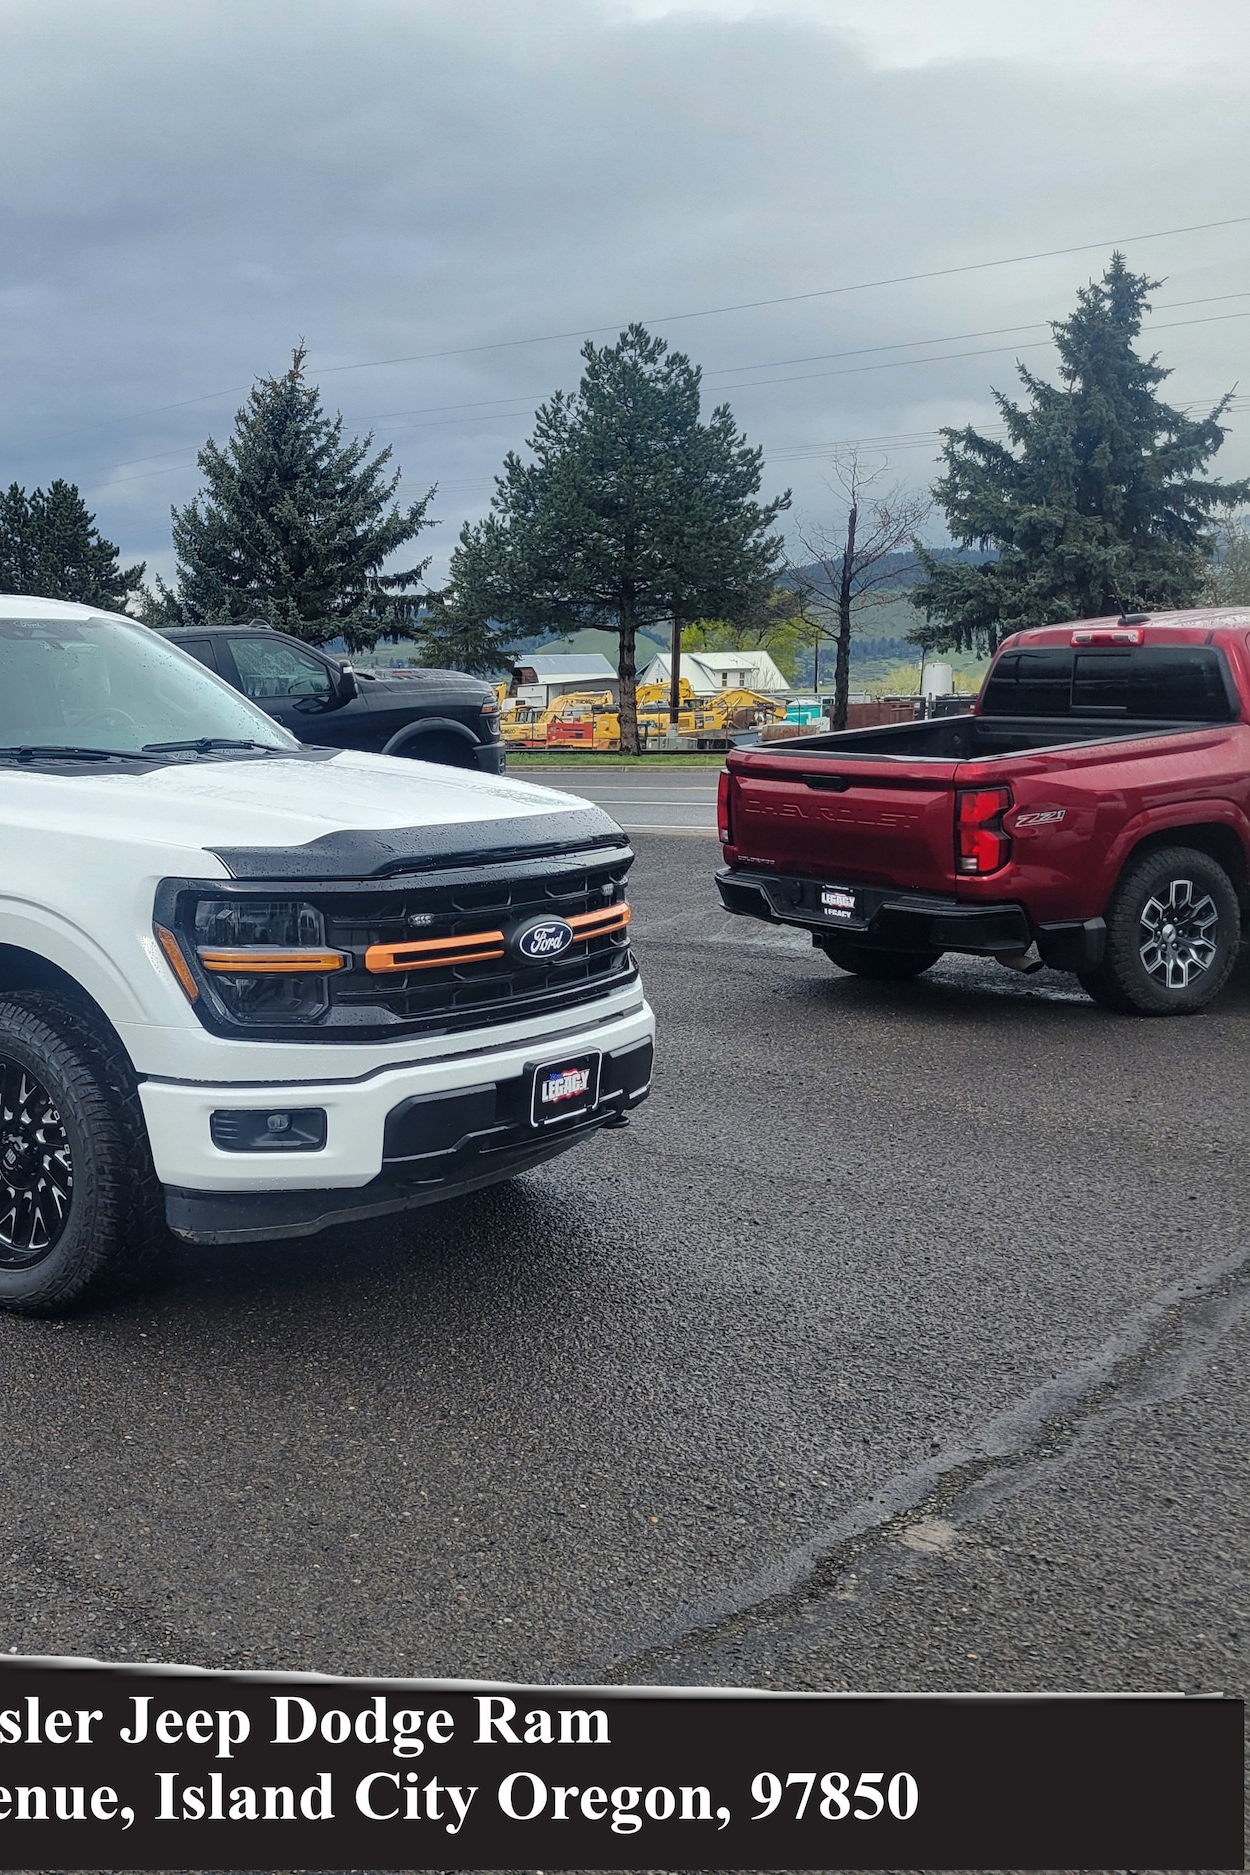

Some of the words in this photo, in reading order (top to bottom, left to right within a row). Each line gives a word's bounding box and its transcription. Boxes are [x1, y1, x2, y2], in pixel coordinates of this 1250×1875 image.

[821, 891, 855, 908] LEGACY
[530, 926, 564, 953] Ford
[541, 1068, 591, 1103] LEGACY
